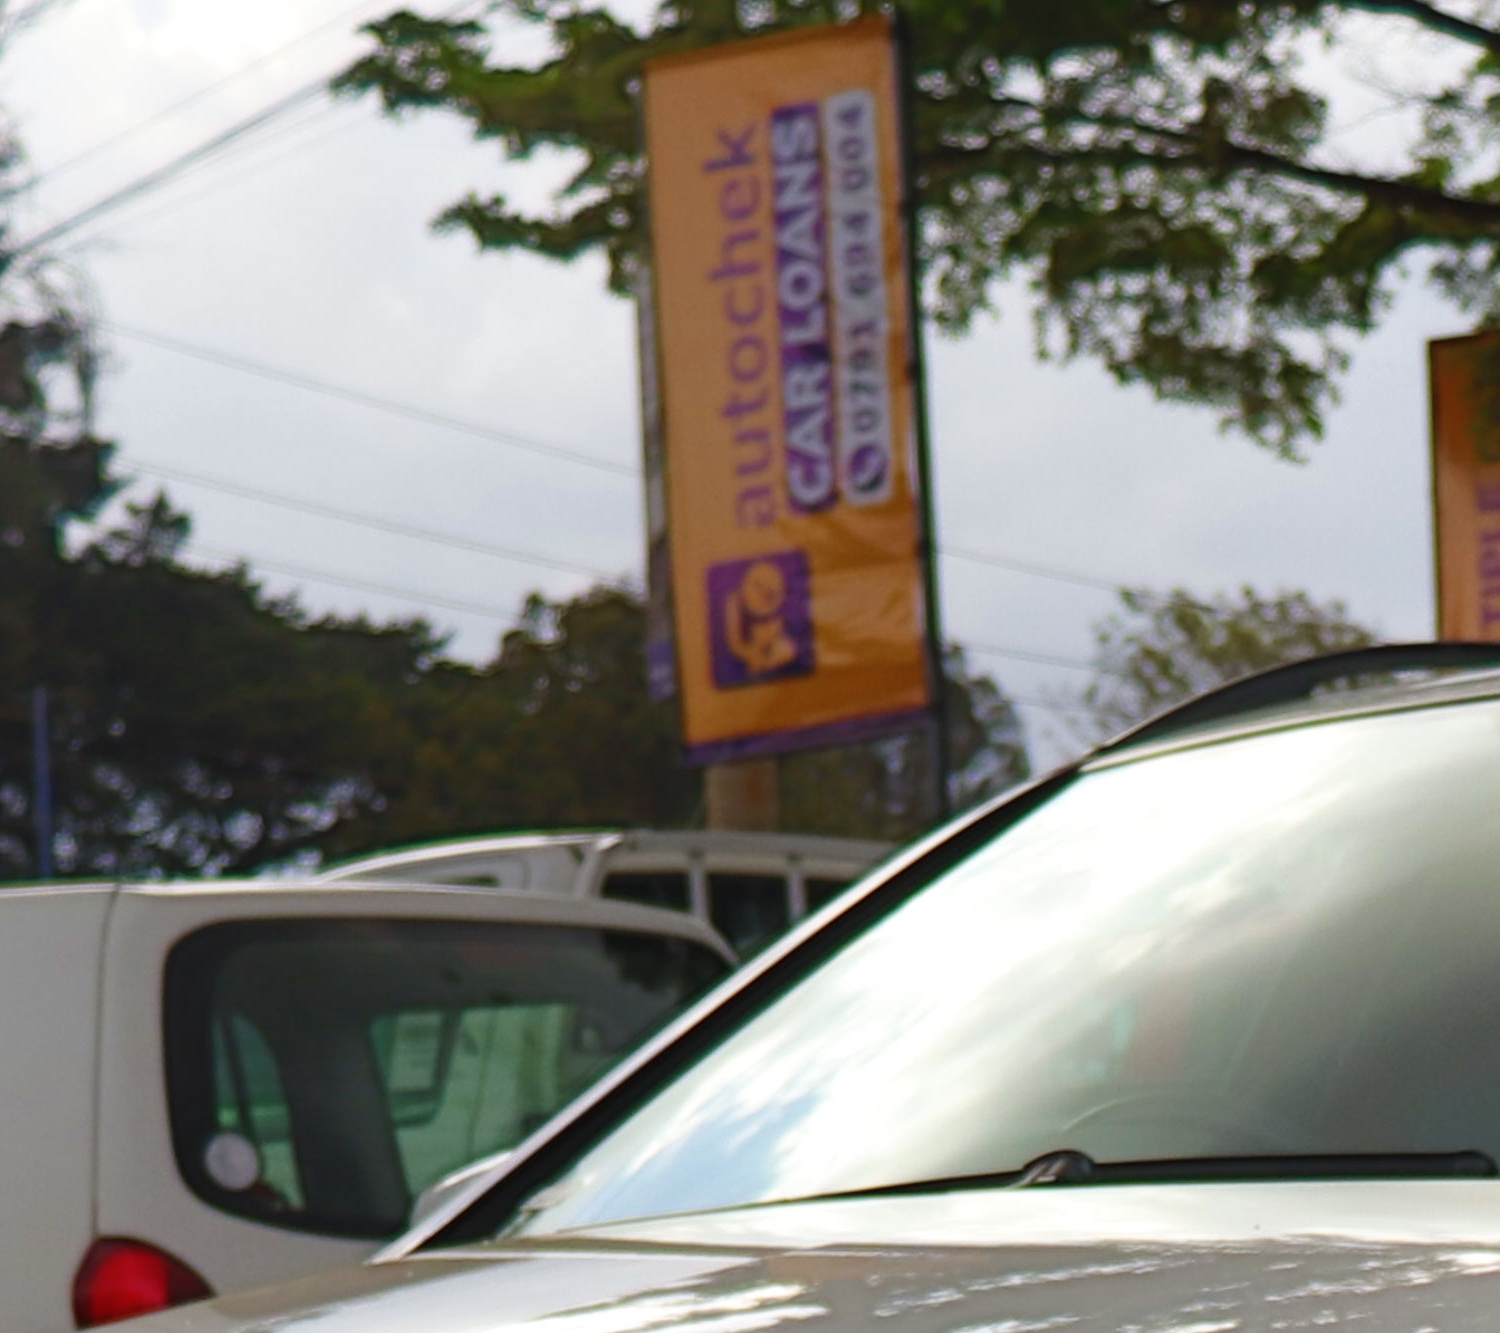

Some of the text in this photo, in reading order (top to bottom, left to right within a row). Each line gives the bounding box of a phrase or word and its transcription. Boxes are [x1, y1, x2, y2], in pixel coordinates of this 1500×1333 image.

[703, 120, 776, 529] autochek
[773, 116, 835, 506] CAR LOANS
